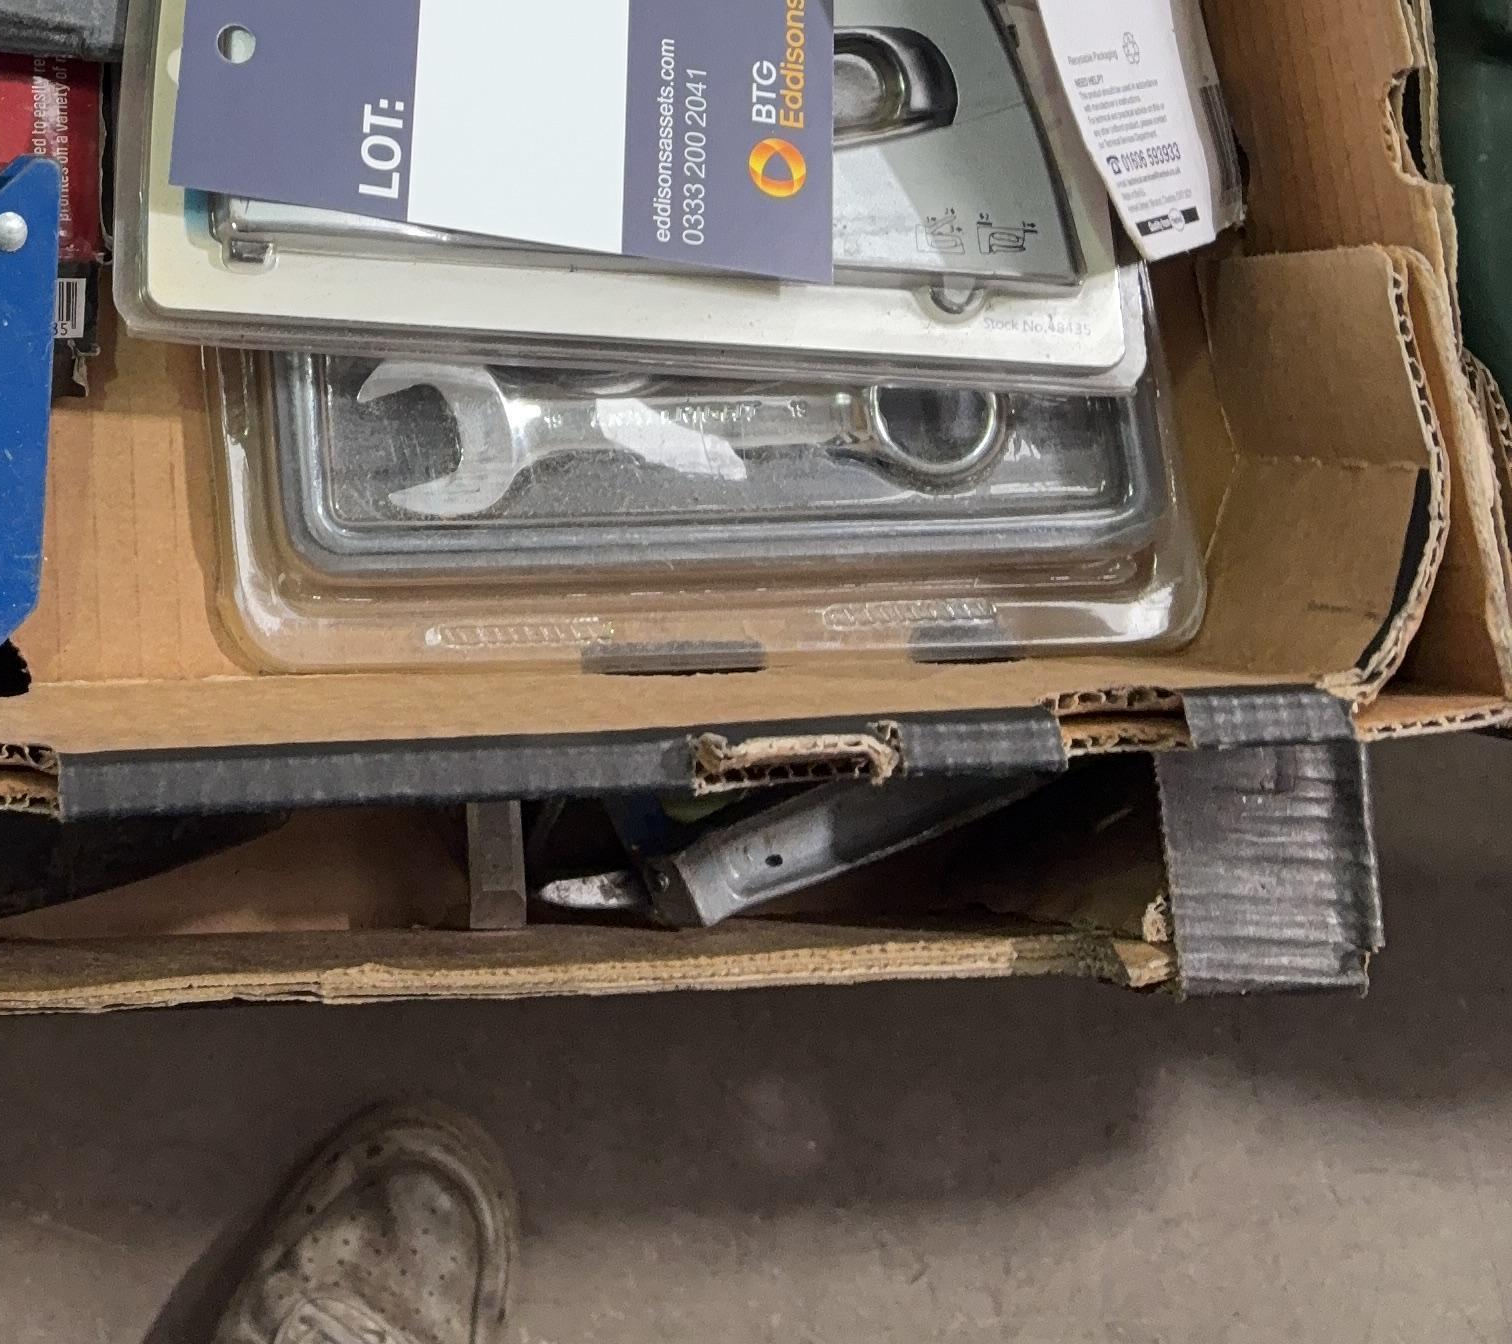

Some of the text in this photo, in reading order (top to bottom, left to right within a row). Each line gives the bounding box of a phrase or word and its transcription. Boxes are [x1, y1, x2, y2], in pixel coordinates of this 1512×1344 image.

[30, 75, 48, 134] to easily
[53, 83, 71, 131] variety
[751, 58, 778, 125] BTG
[358, 97, 405, 201] LOT:
[653, 37, 677, 243] eddisonsassets.com
[682, 66, 709, 246] 0333 200 2041
[1120, 141, 1181, 172] 01606 593933
